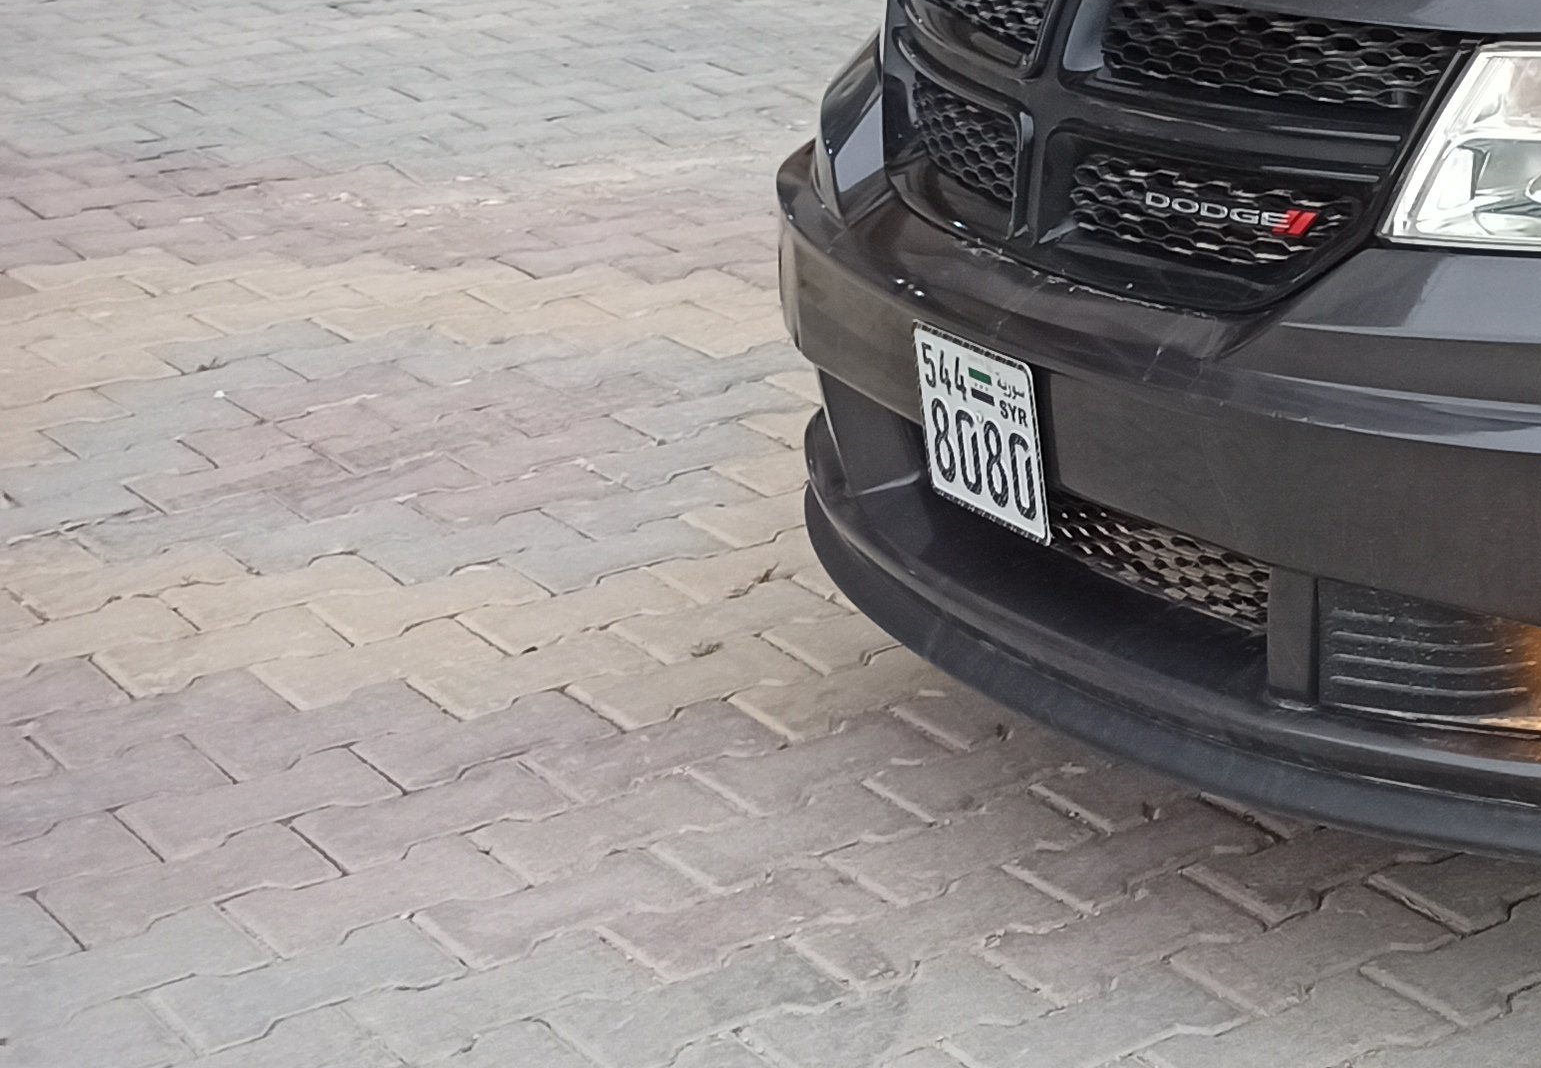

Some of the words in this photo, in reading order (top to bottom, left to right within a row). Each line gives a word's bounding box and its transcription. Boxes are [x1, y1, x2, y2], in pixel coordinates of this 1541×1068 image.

[1145, 191, 1291, 229] DODGE
[921, 341, 968, 402] 544
[999, 399, 1028, 427] SYR
[931, 397, 1037, 521] 8080
